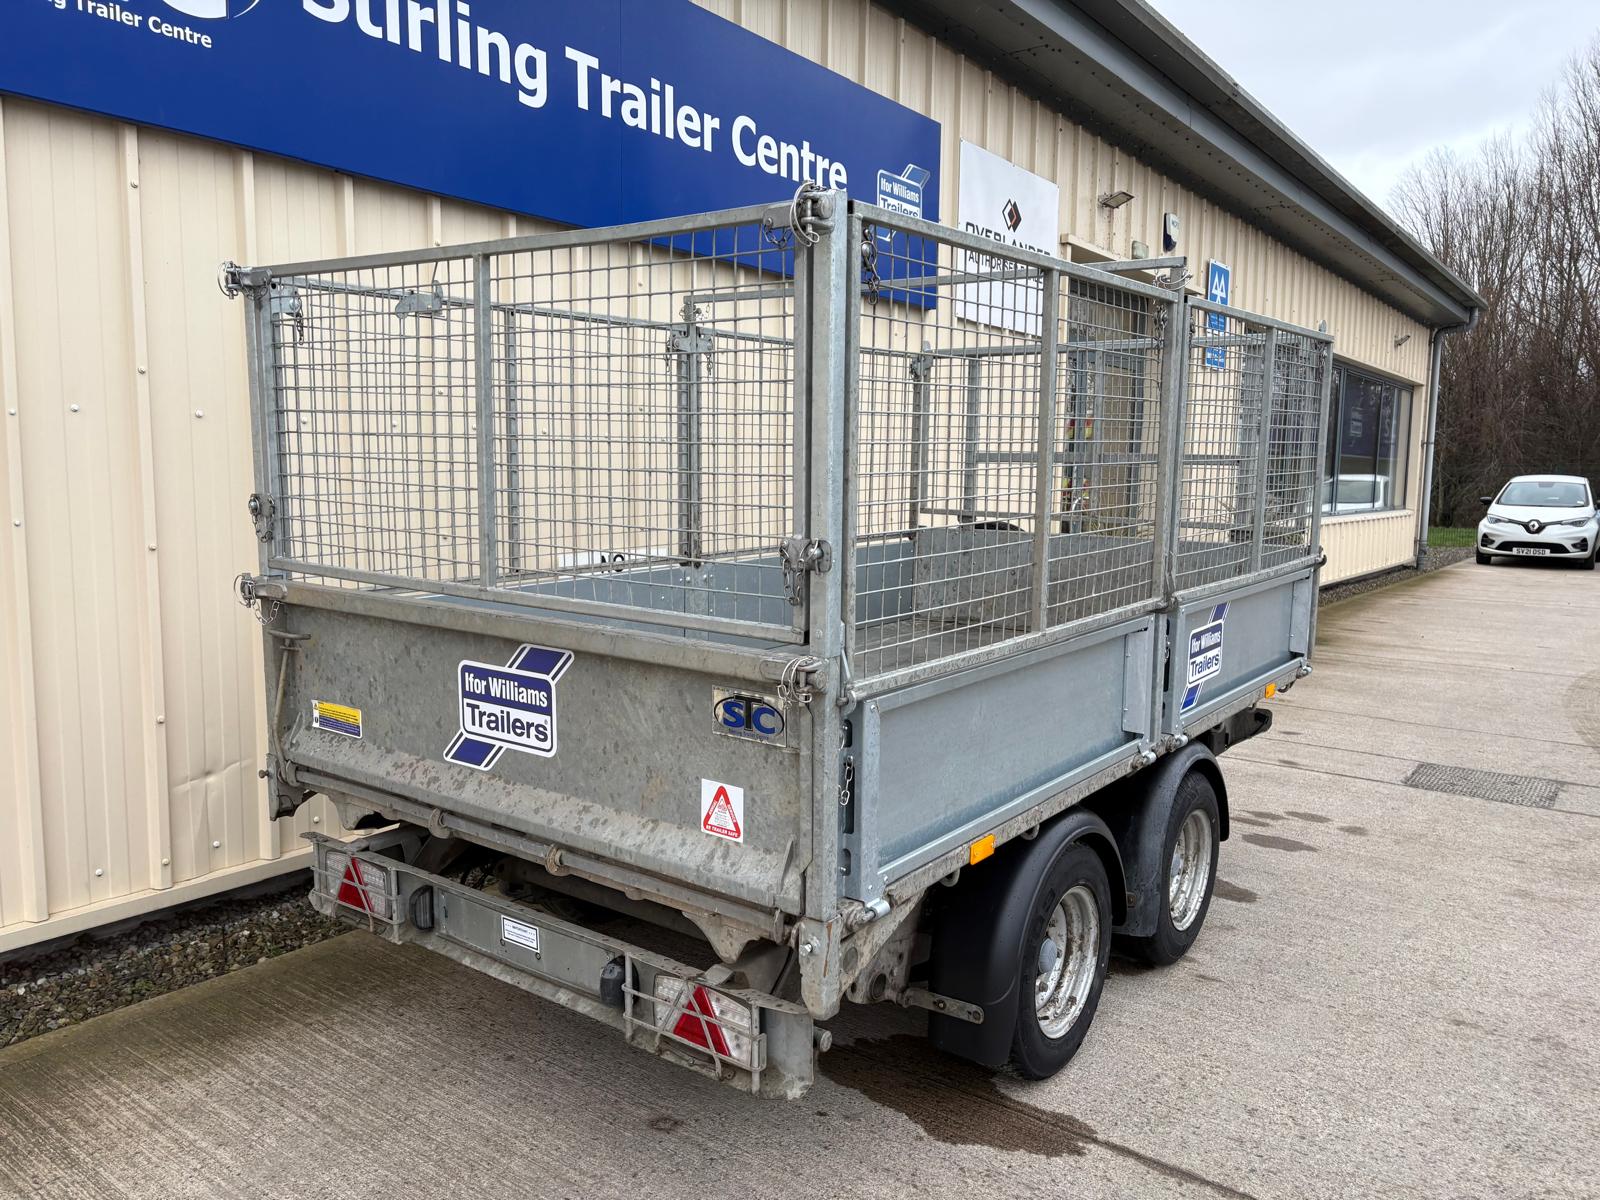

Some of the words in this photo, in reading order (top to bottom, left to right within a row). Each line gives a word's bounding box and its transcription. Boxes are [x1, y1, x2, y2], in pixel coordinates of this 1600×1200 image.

[148, 16, 212, 48] Centre
[565, 46, 720, 152] Trailer
[732, 115, 848, 191] Centre
[880, 177, 892, 193] Ifor
[893, 181, 920, 203] Williams
[966, 221, 1050, 256] OVERL
[968, 251, 1018, 272] AUTHORSE
[1191, 654, 1220, 677] Trailers
[465, 672, 487, 695] Ifor
[488, 676, 548, 708] Williams
[466, 702, 549, 743] Trailers
[722, 693, 776, 735] STC
